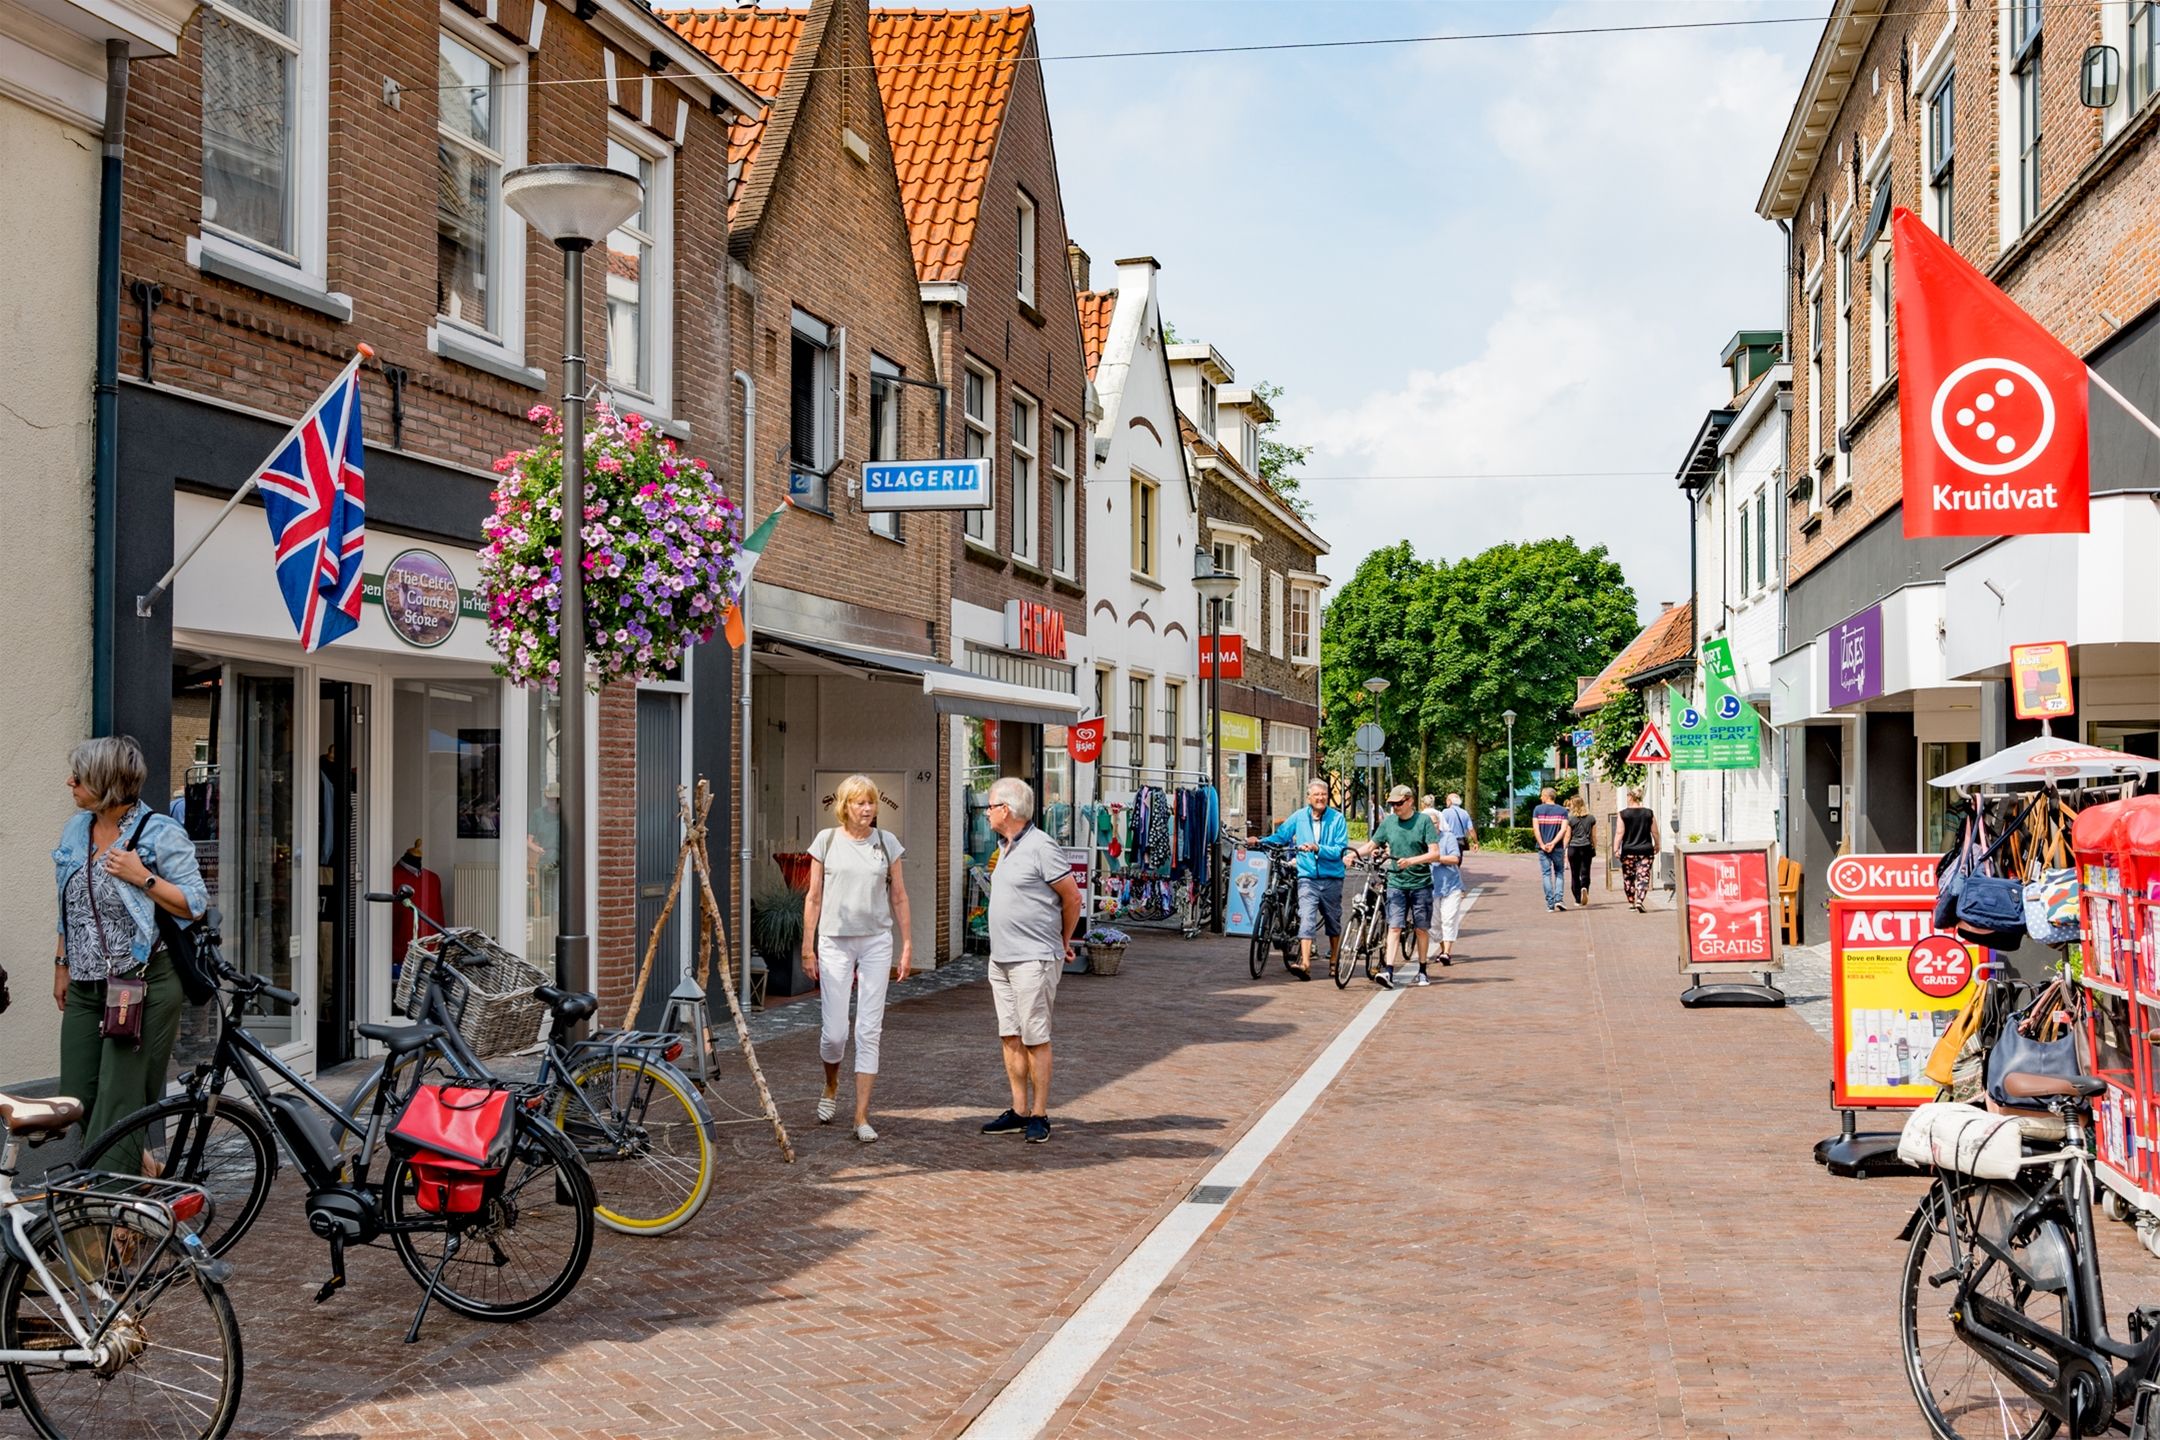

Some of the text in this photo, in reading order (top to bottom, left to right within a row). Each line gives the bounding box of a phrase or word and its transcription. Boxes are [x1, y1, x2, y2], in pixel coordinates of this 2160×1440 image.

[871, 469, 975, 488] SLAGERIJ
[1932, 482, 2059, 511] Kruidvat
[397, 569, 454, 591] The Celtic
[407, 590, 456, 613] Country
[404, 609, 438, 627] Store
[1020, 599, 1067, 660] HEMA
[1201, 651, 1238, 664] HMA
[1710, 726, 1753, 734] SPORT
[1076, 741, 1095, 752] ijsje?
[917, 771, 932, 782] 49
[1721, 863, 1735, 879] ten
[1869, 864, 1934, 887] Kruid
[1718, 879, 1738, 896] Cate
[1698, 911, 1763, 939] 2 + 1
[1914, 948, 1965, 974] 2+2
[1923, 976, 1957, 985] GRATIS
